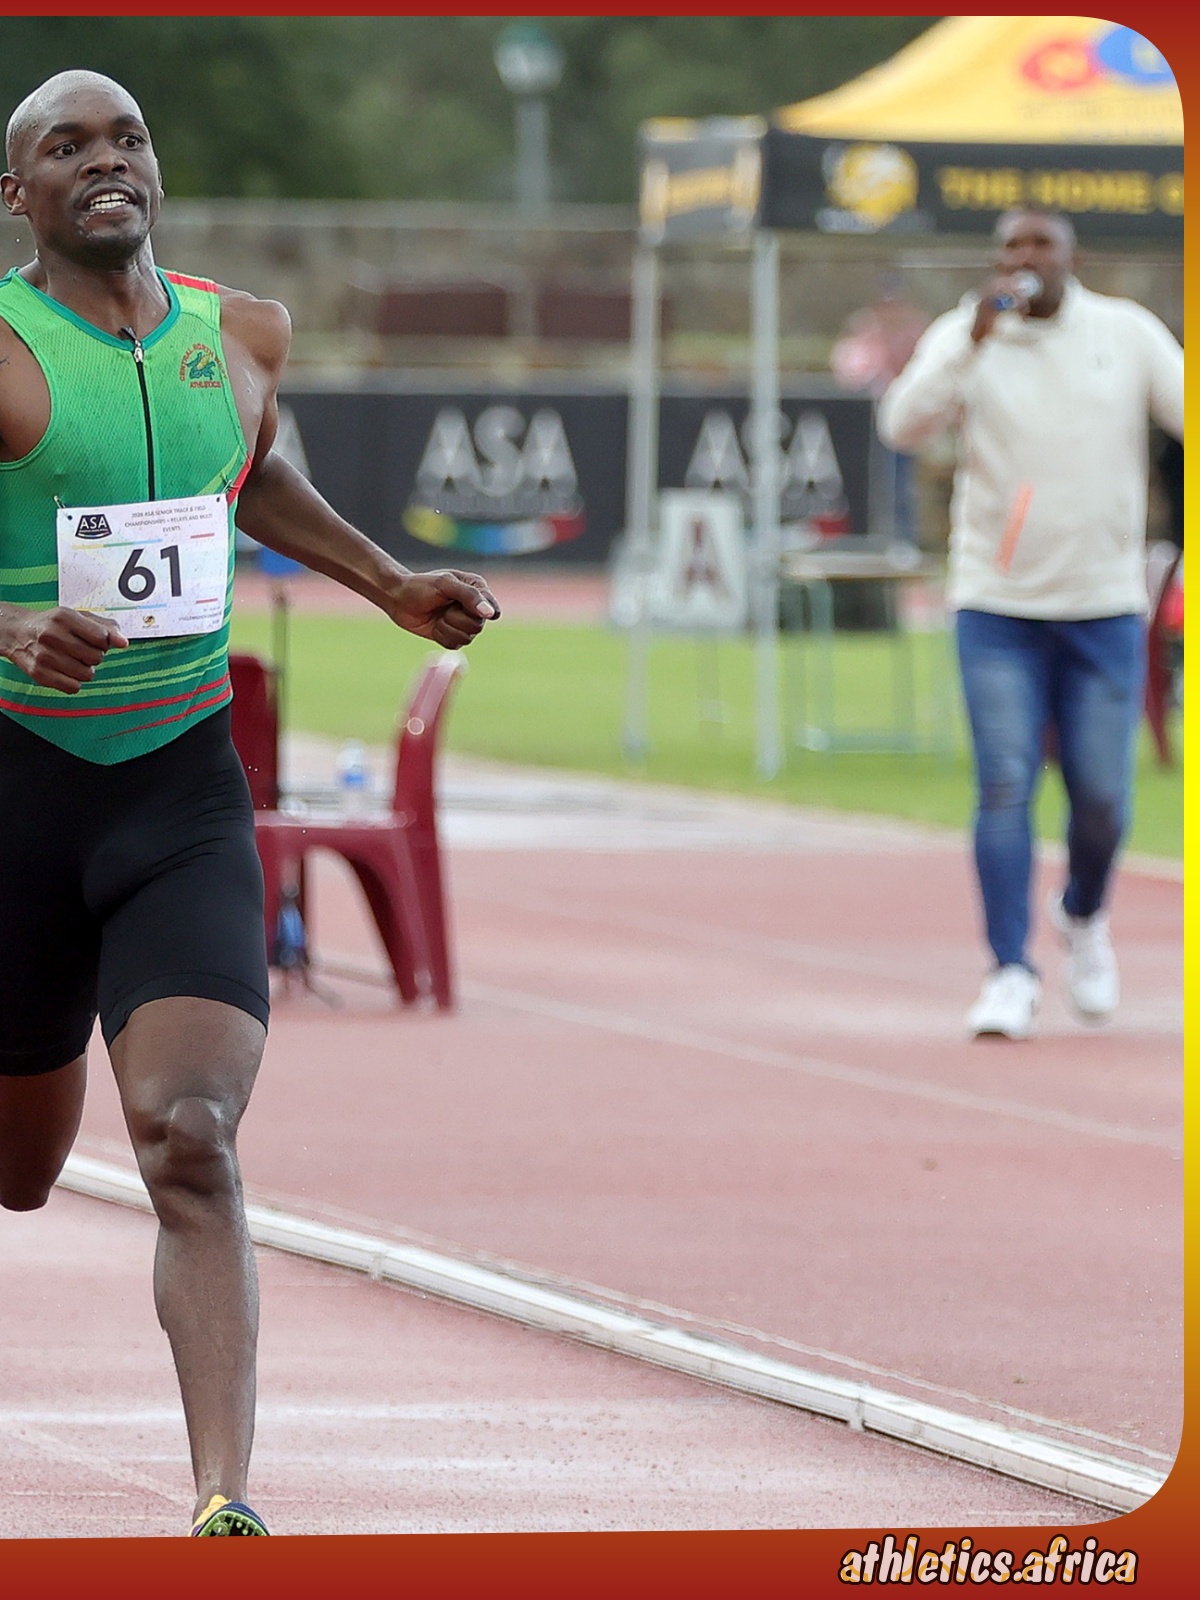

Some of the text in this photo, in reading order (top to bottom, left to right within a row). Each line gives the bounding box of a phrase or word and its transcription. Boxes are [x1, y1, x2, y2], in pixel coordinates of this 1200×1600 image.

[415, 405, 580, 497] ASA
[80, 516, 108, 530] ASA
[118, 544, 182, 602] 61
